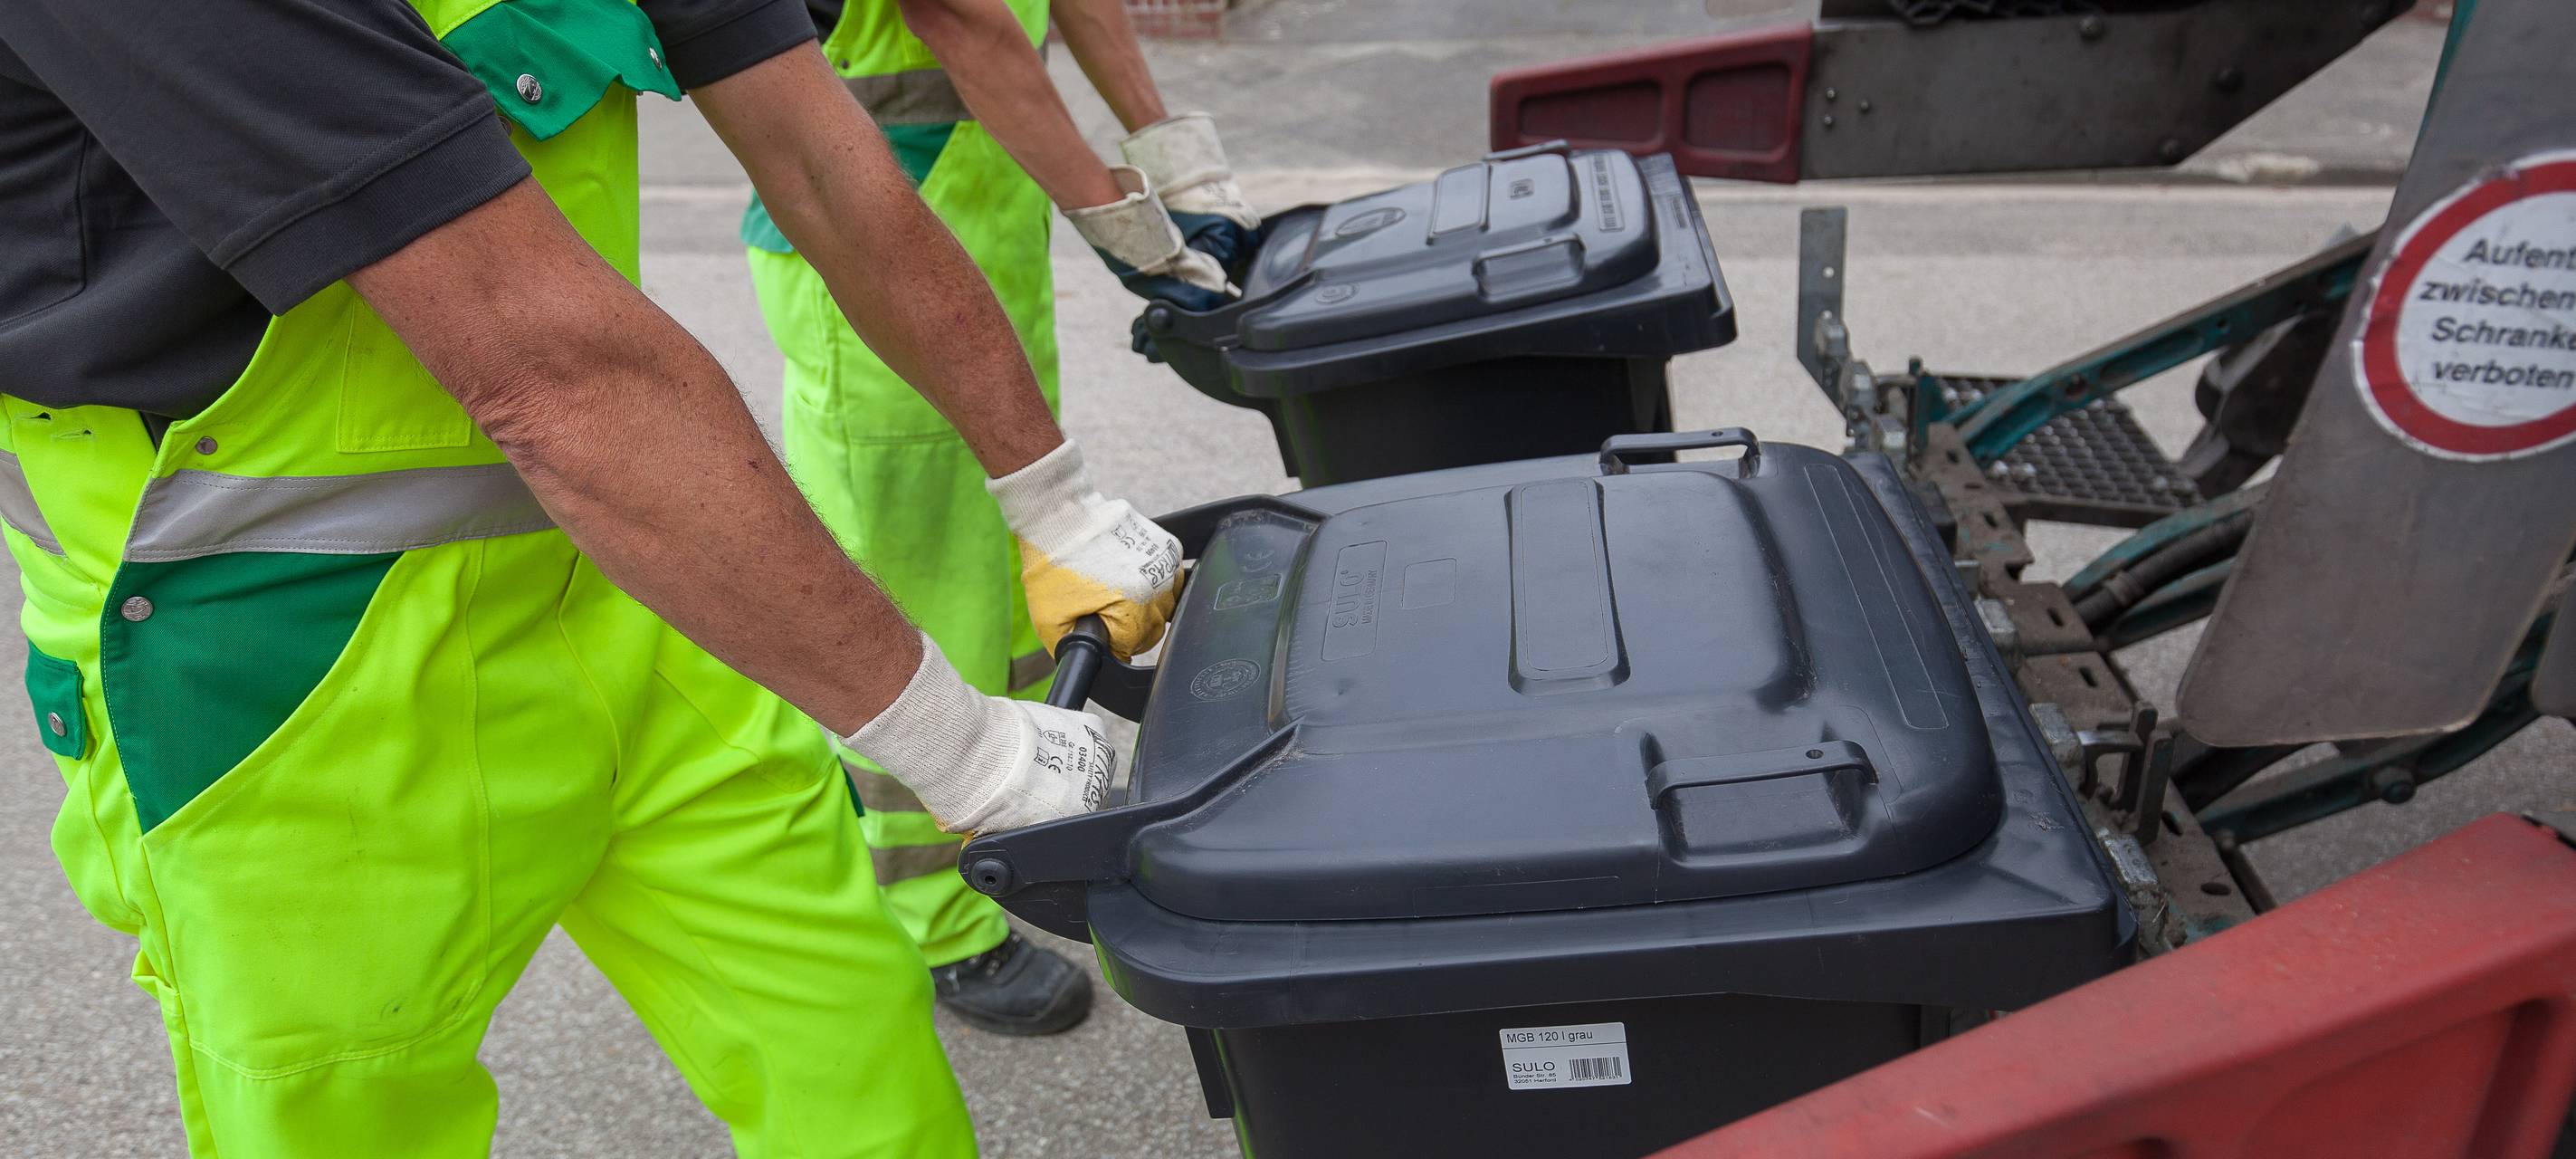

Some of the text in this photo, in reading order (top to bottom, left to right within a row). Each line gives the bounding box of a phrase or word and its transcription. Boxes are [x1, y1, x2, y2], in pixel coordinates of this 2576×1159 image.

[2419, 278, 2576, 311] zwischen
[2433, 359, 2575, 389] verboten
[1077, 746, 1087, 772] 03400
[1506, 1032, 1535, 1043] MGB
[1539, 1031, 1559, 1041] 120
[1568, 1030, 1593, 1042] grau
[1512, 1061, 1555, 1072] SULO
